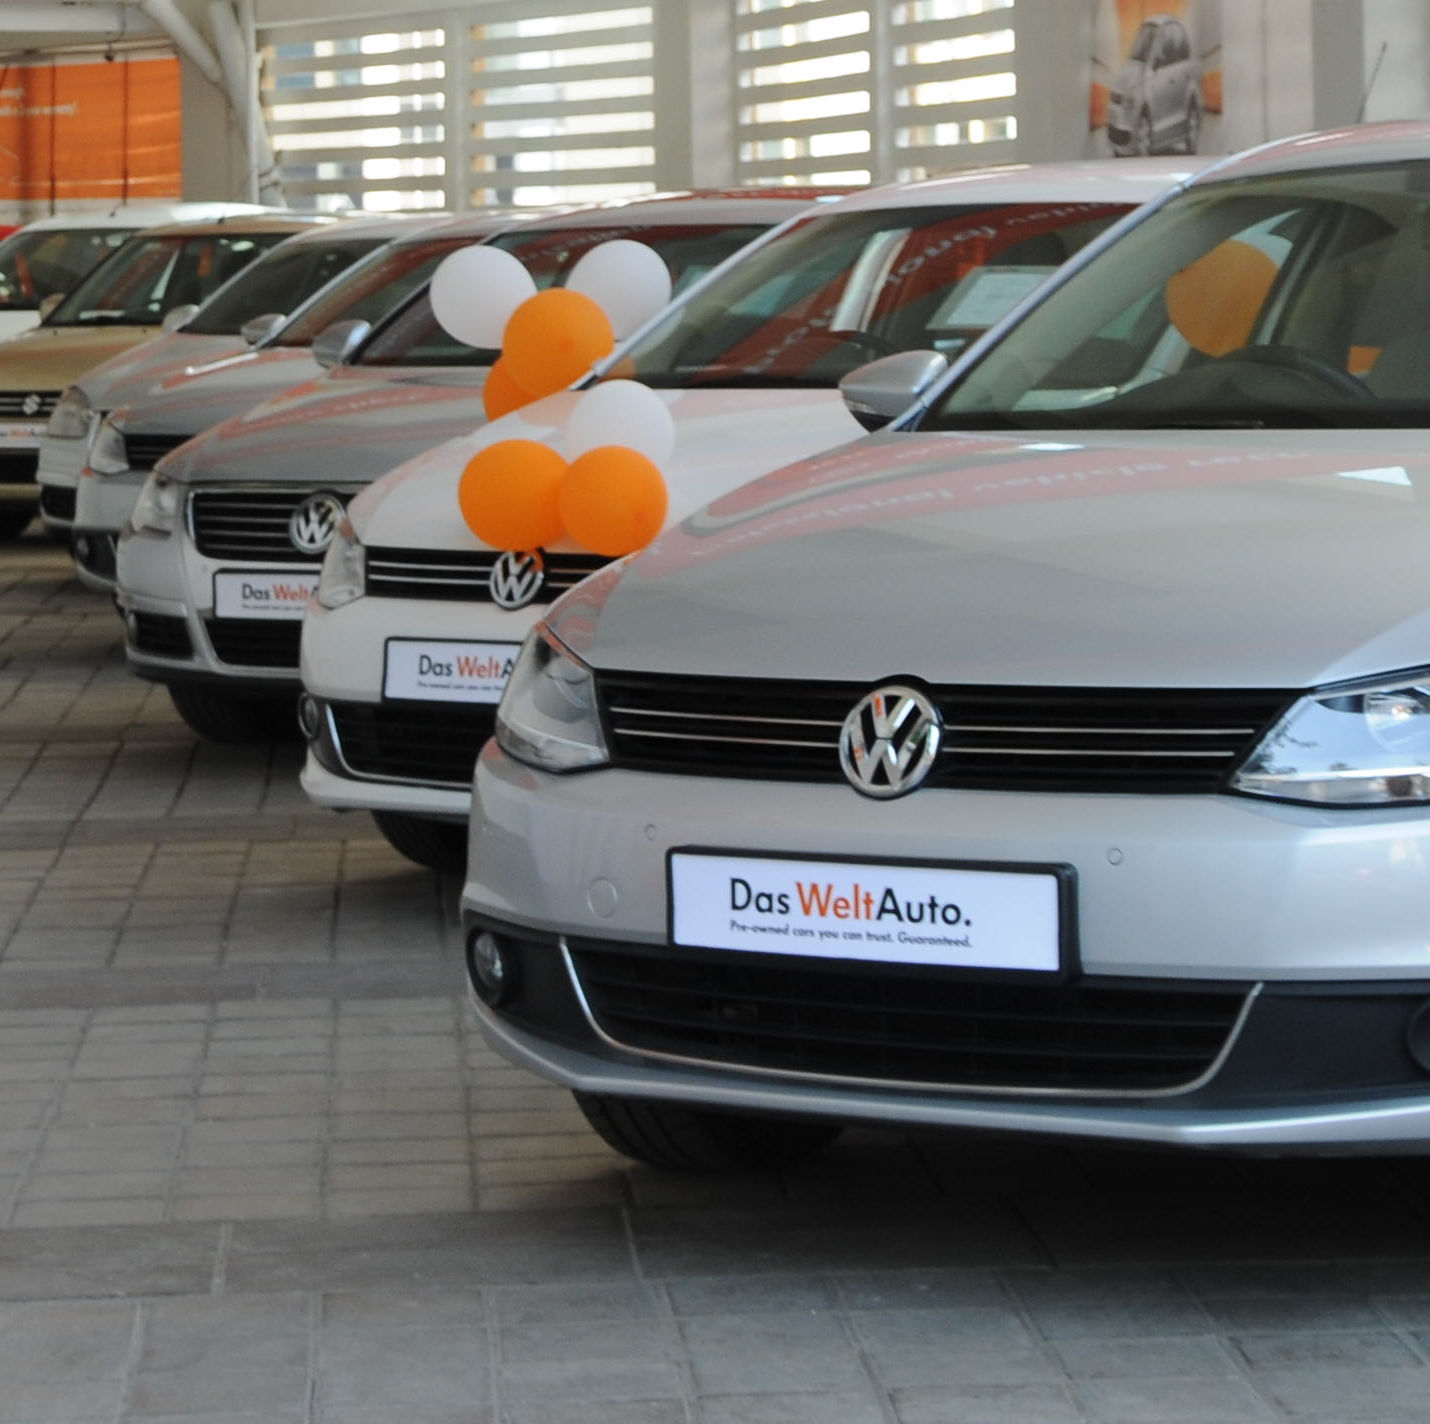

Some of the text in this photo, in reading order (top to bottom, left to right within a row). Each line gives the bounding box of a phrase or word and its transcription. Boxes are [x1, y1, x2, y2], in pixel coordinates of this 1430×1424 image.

[241, 582, 271, 601] Das
[418, 653, 453, 677] Das
[729, 876, 973, 927] Das WeltAuto.
[729, 919, 973, 948] Pre-owned cars you can trust. Guaranteed.
